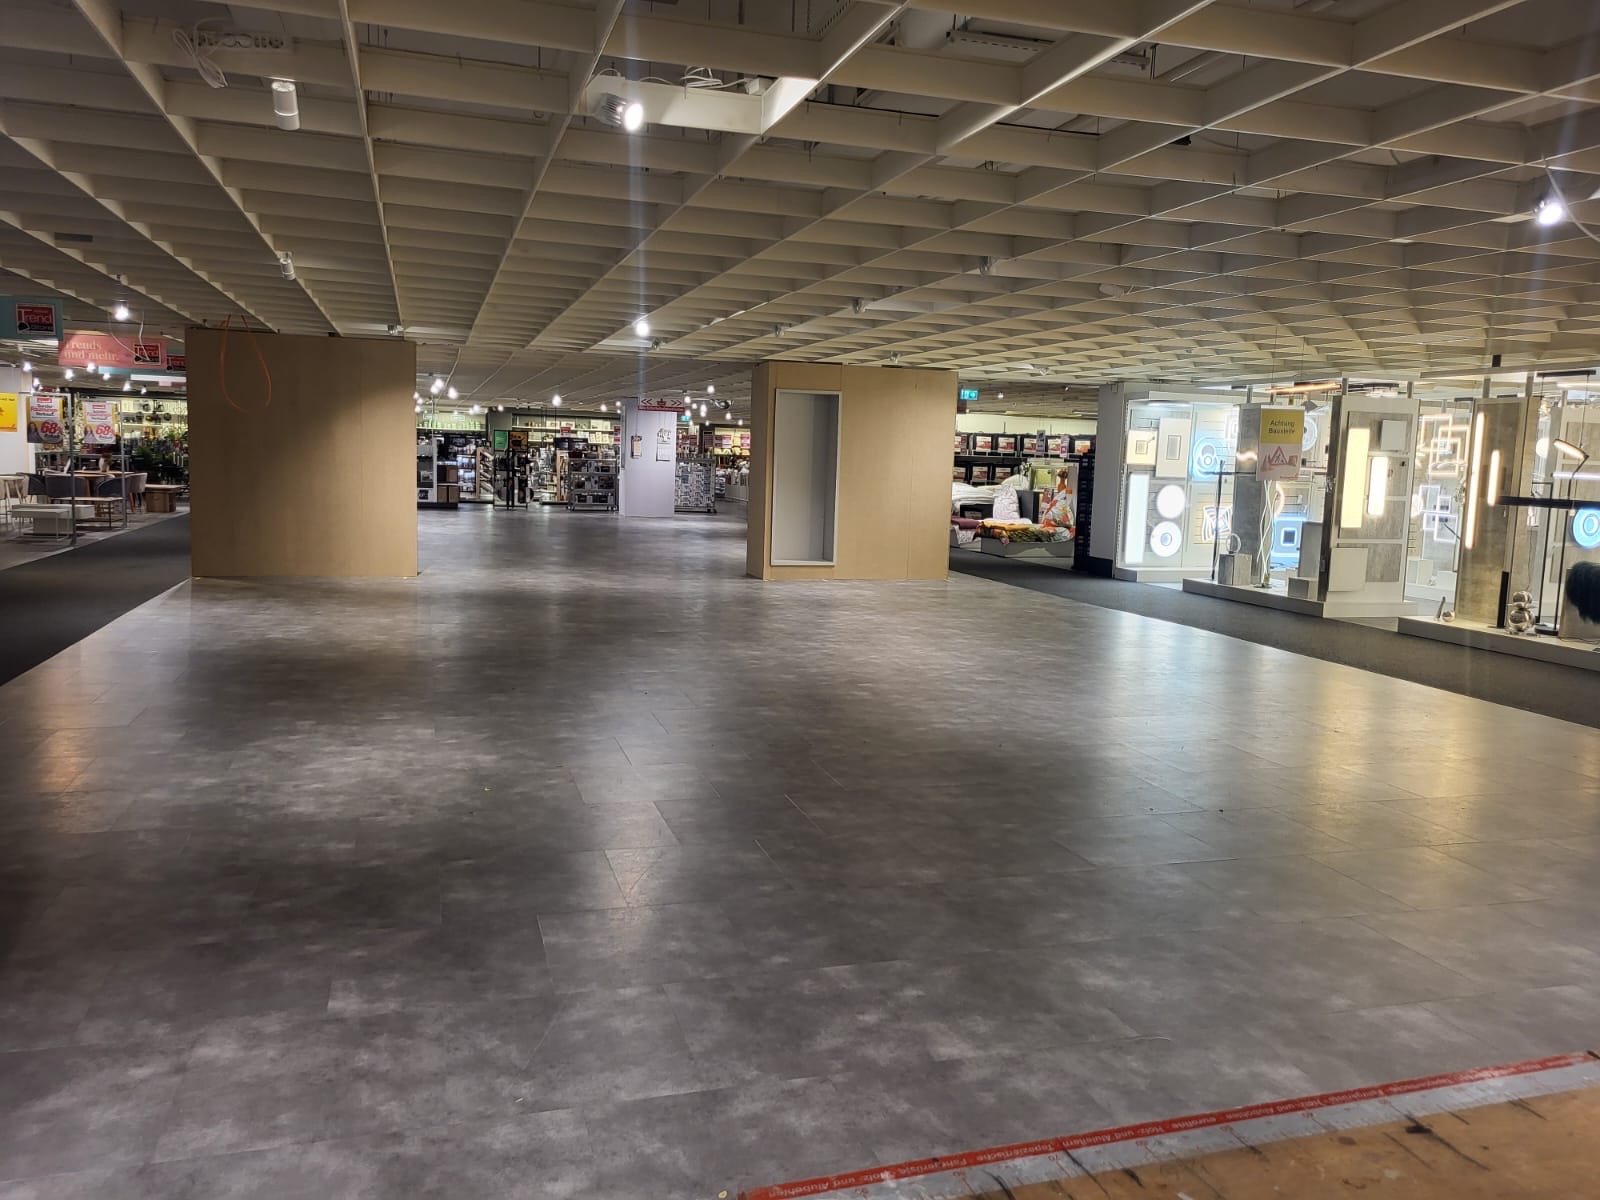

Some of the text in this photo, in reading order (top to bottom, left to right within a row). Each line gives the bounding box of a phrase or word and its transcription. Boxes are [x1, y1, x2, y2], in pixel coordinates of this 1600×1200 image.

[16, 308, 52, 324] Trend
[64, 350, 85, 359] und
[1269, 419, 1296, 428] Achtung
[832, 1176, 854, 1186] und
